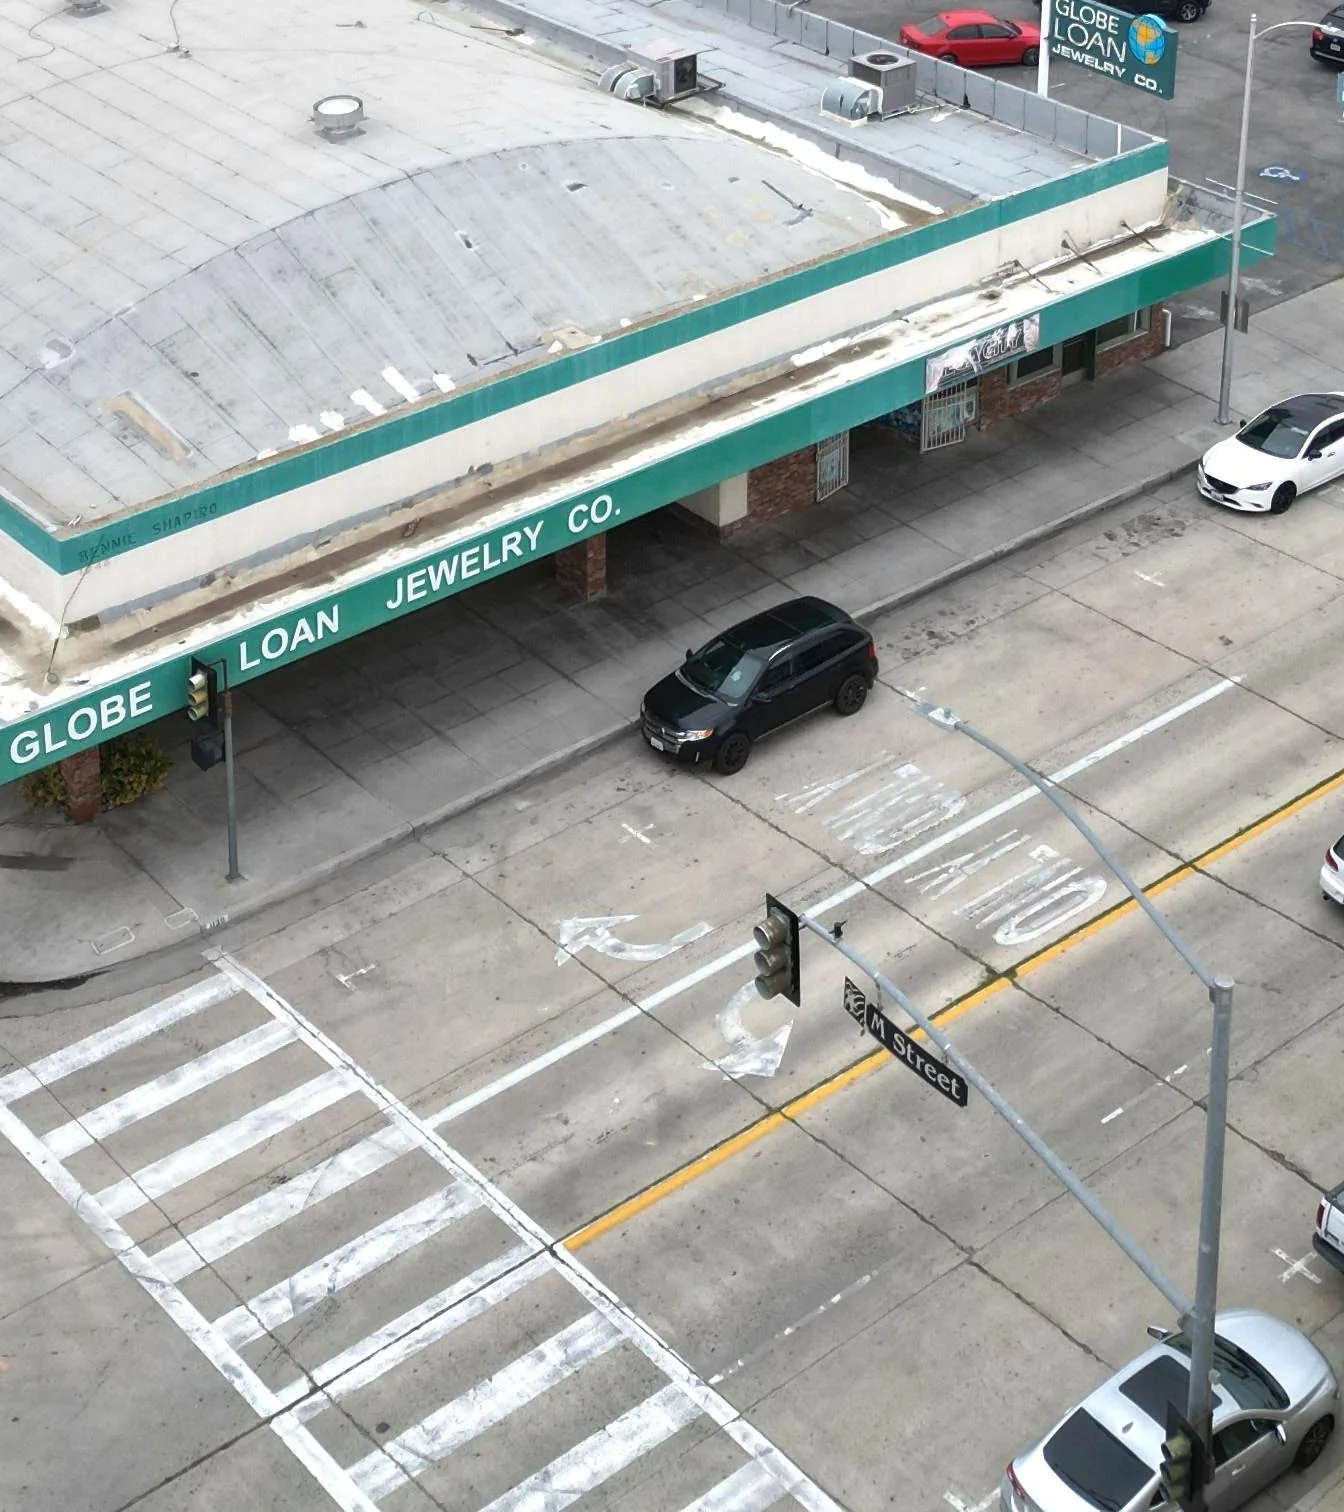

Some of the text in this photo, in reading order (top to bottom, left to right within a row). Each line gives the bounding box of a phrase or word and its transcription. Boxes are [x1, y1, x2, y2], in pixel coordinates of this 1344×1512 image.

[1052, 43, 1163, 94] JEWELRY CO.
[1054, 17, 1127, 63] LOAN
[78, 502, 218, 563] BENNIE SHAPIRO
[10, 494, 622, 765] GLOBE LOAN JEWELRY CO.
[871, 1011, 961, 1100] M Street
